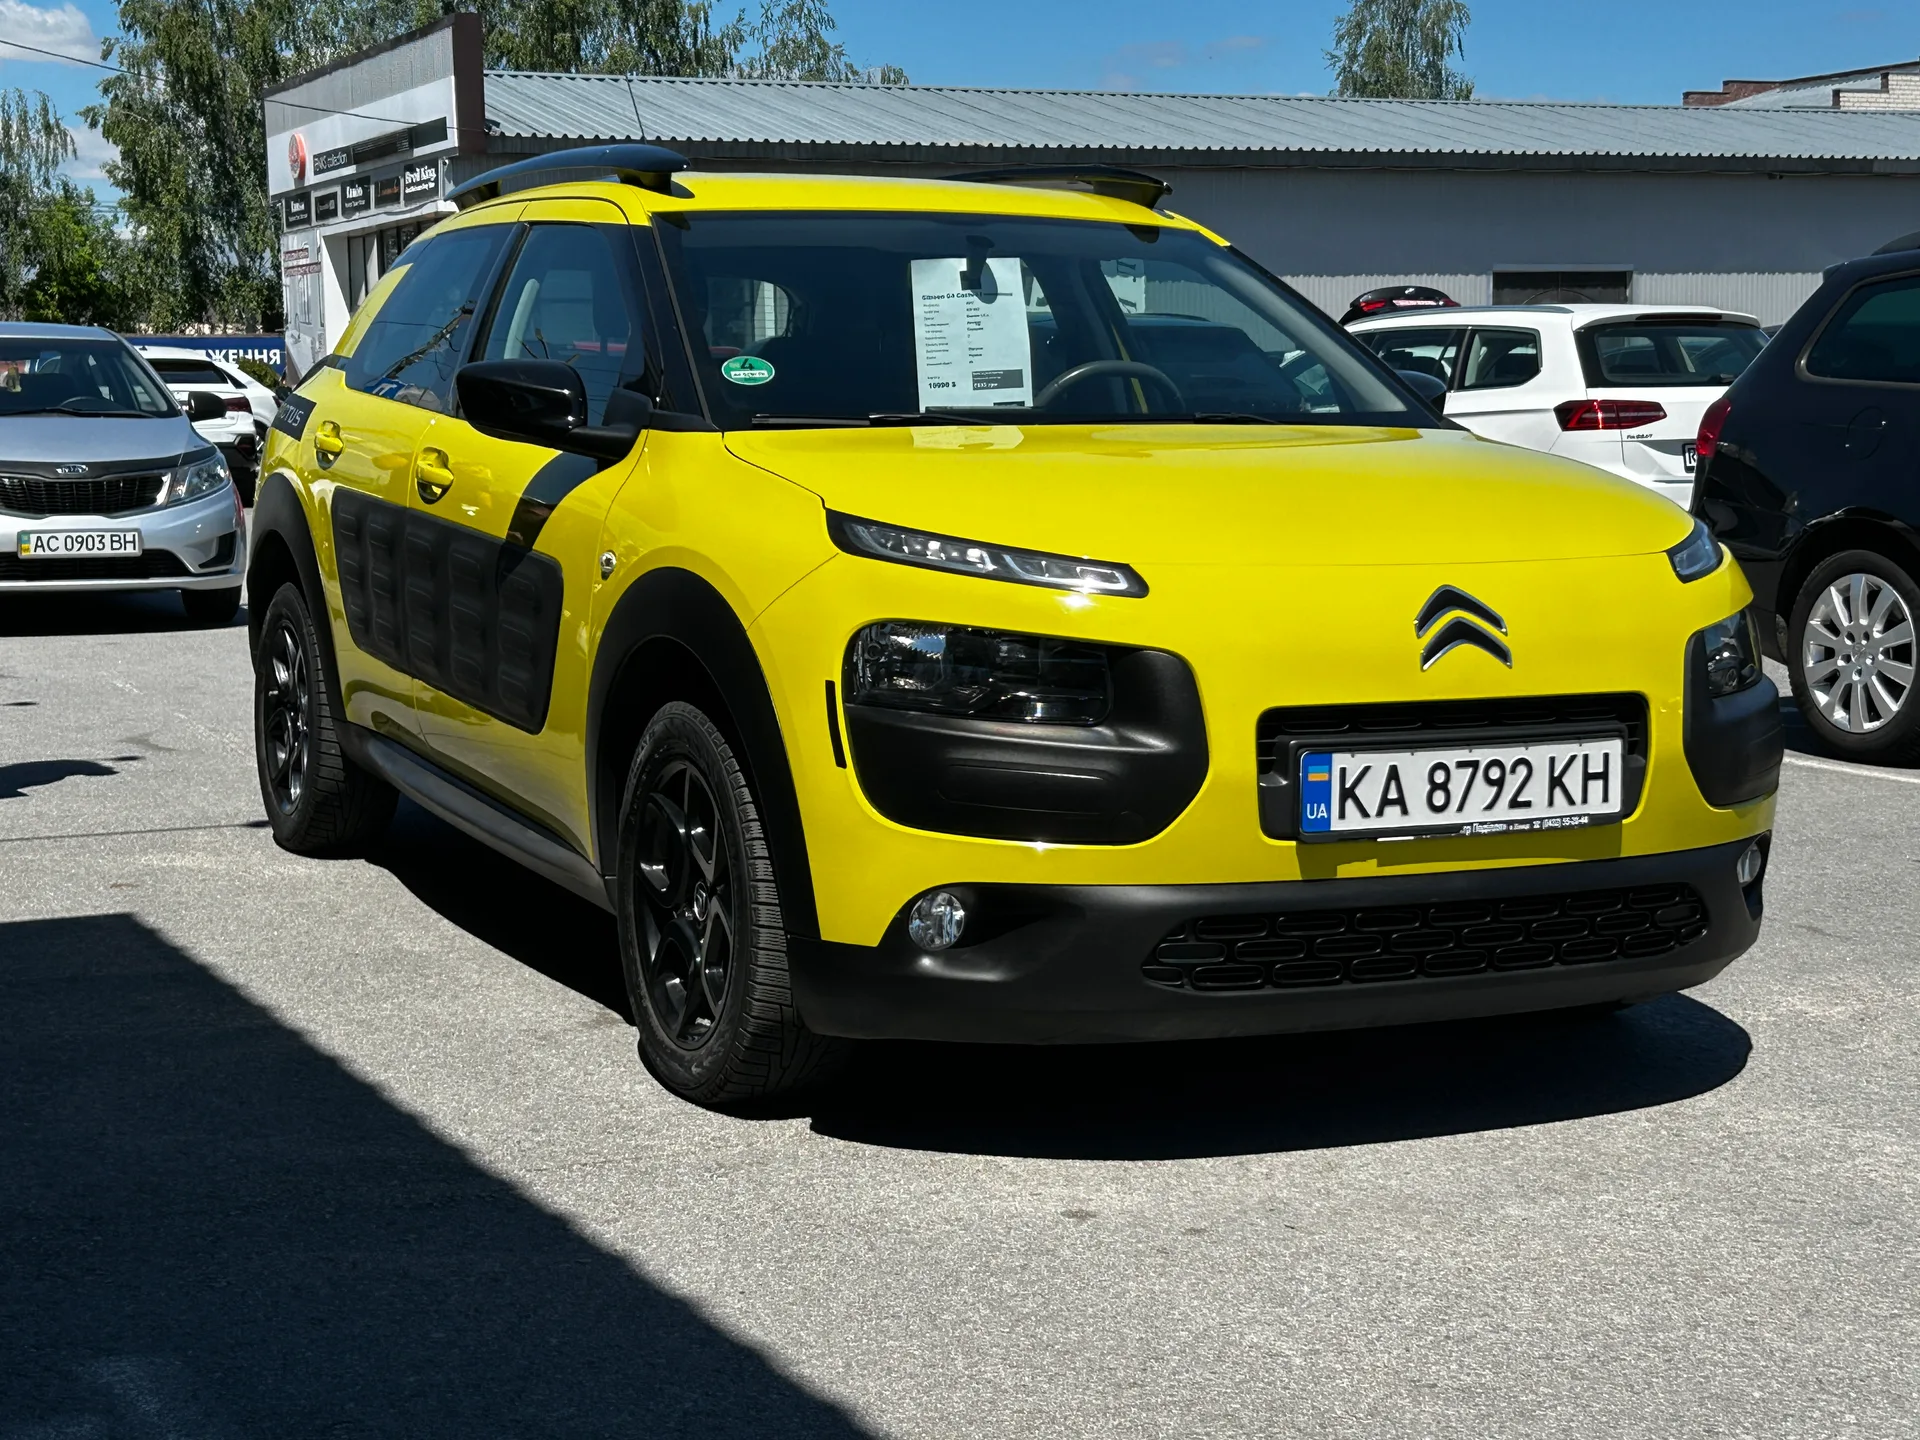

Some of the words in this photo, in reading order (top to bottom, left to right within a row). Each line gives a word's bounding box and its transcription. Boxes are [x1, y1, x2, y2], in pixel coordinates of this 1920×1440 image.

[206, 349, 281, 365] ЖЕННЯ
[740, 358, 755, 370] 4
[33, 535, 60, 553] AC
[64, 534, 106, 552] 0903
[110, 533, 136, 551] BH
[1338, 764, 1409, 820] KA
[1426, 756, 1533, 813] 8792
[1547, 751, 1610, 809] KH
[1306, 803, 1328, 819] UA
